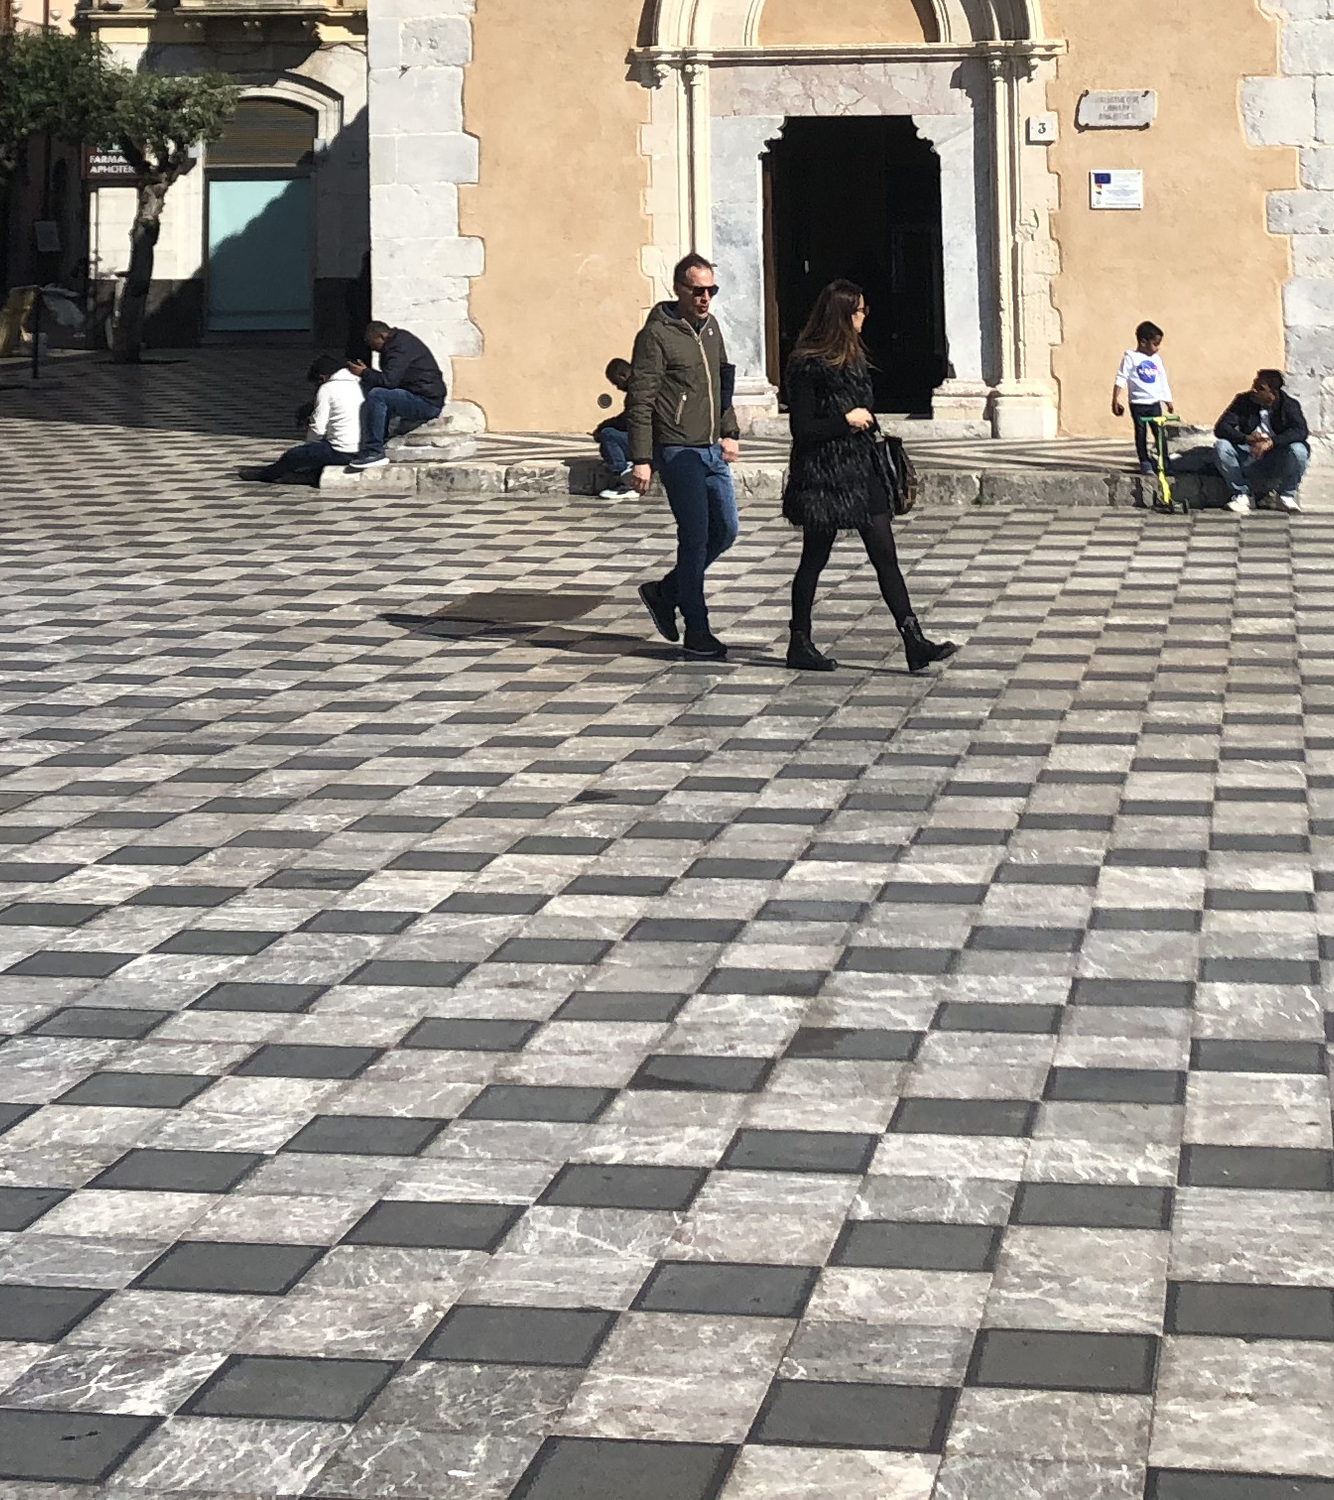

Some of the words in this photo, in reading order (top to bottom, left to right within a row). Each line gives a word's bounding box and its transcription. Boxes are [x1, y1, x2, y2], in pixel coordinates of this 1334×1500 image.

[1037, 122, 1047, 135] 3
[89, 155, 129, 164] FARMA
[89, 165, 136, 174] APHOTEK
